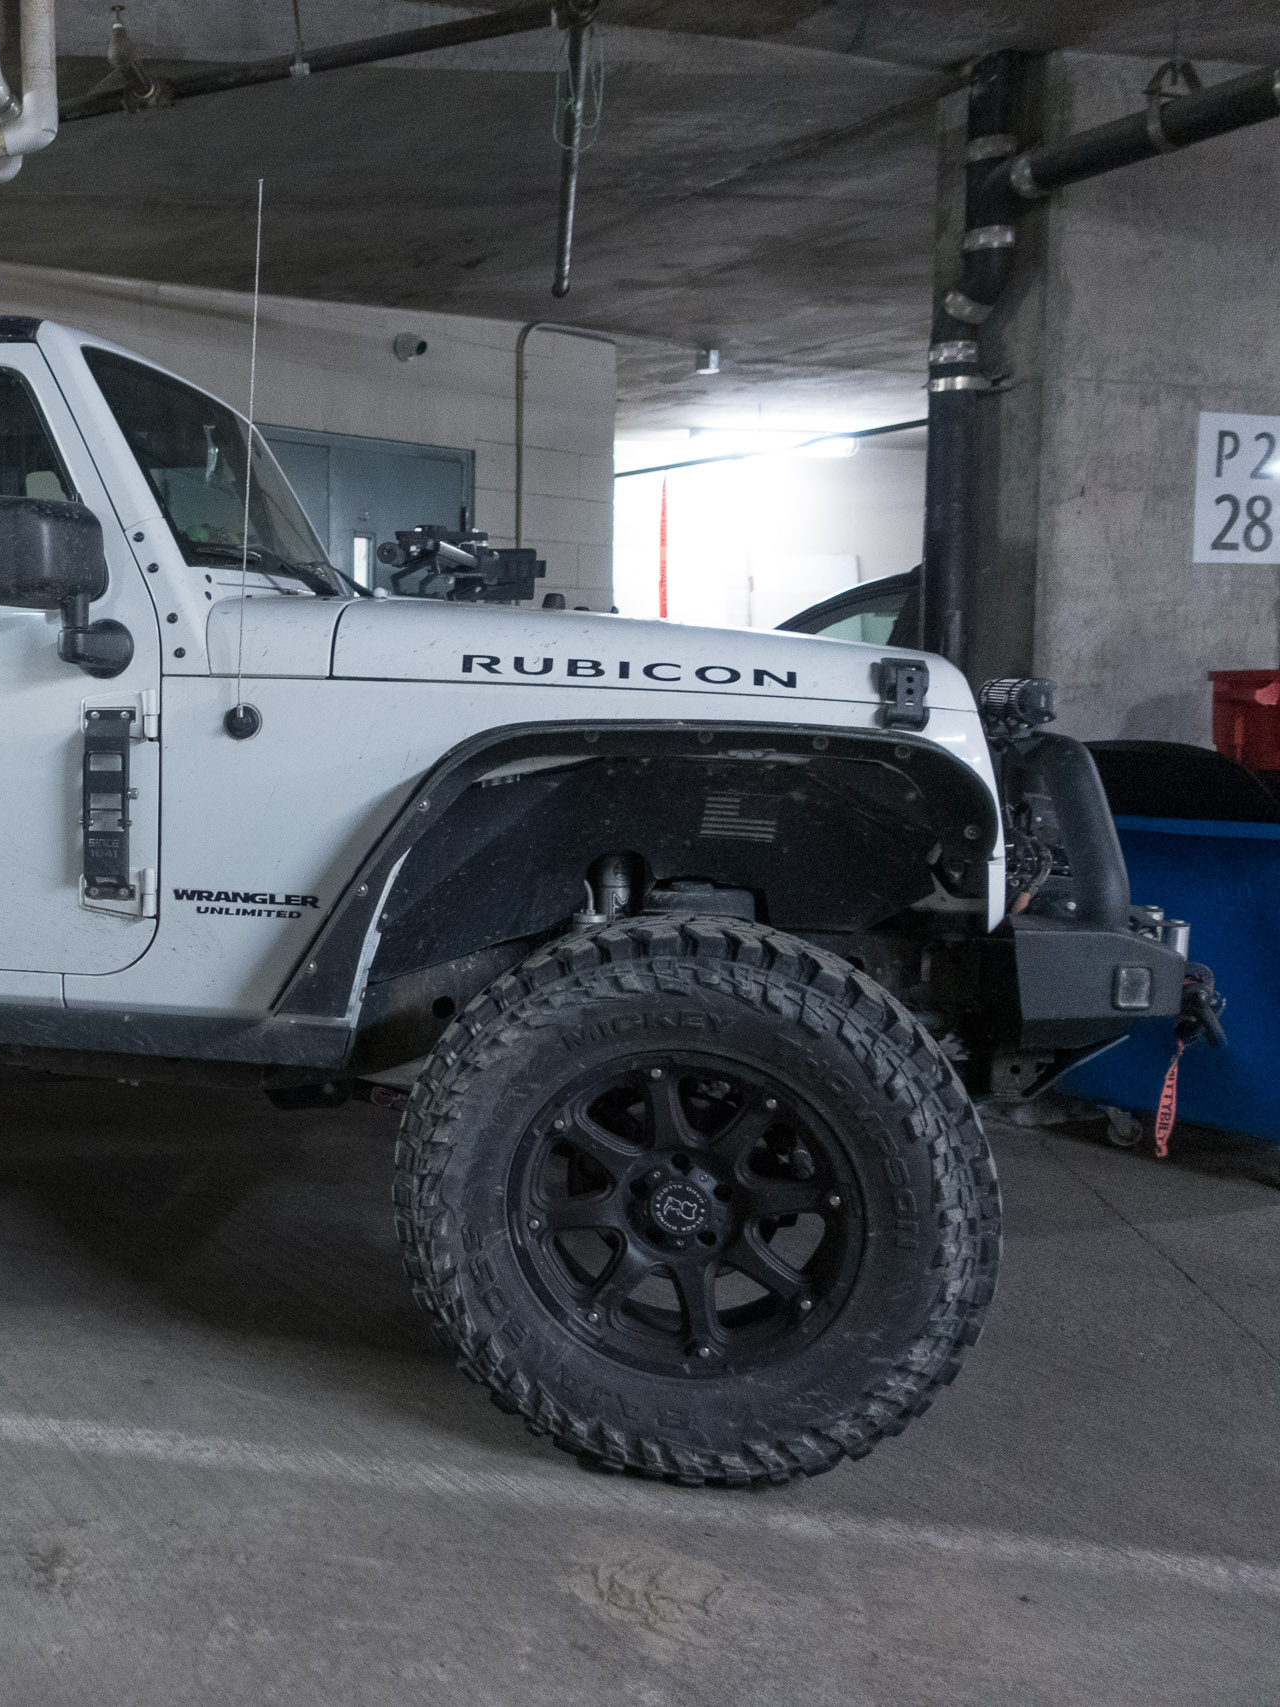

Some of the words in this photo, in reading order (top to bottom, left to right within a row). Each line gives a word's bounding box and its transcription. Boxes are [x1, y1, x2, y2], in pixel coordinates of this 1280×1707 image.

[1214, 429, 1240, 478] P
[1249, 431, 1276, 480] 2
[1210, 493, 1274, 553] 28
[461, 653, 797, 689] RUBICON
[173, 888, 320, 909] WRANGLER
[196, 906, 302, 919] UNLIMITED
[561, 1008, 736, 1052] MICKEY
[772, 1030, 923, 1251] THOMPSON
